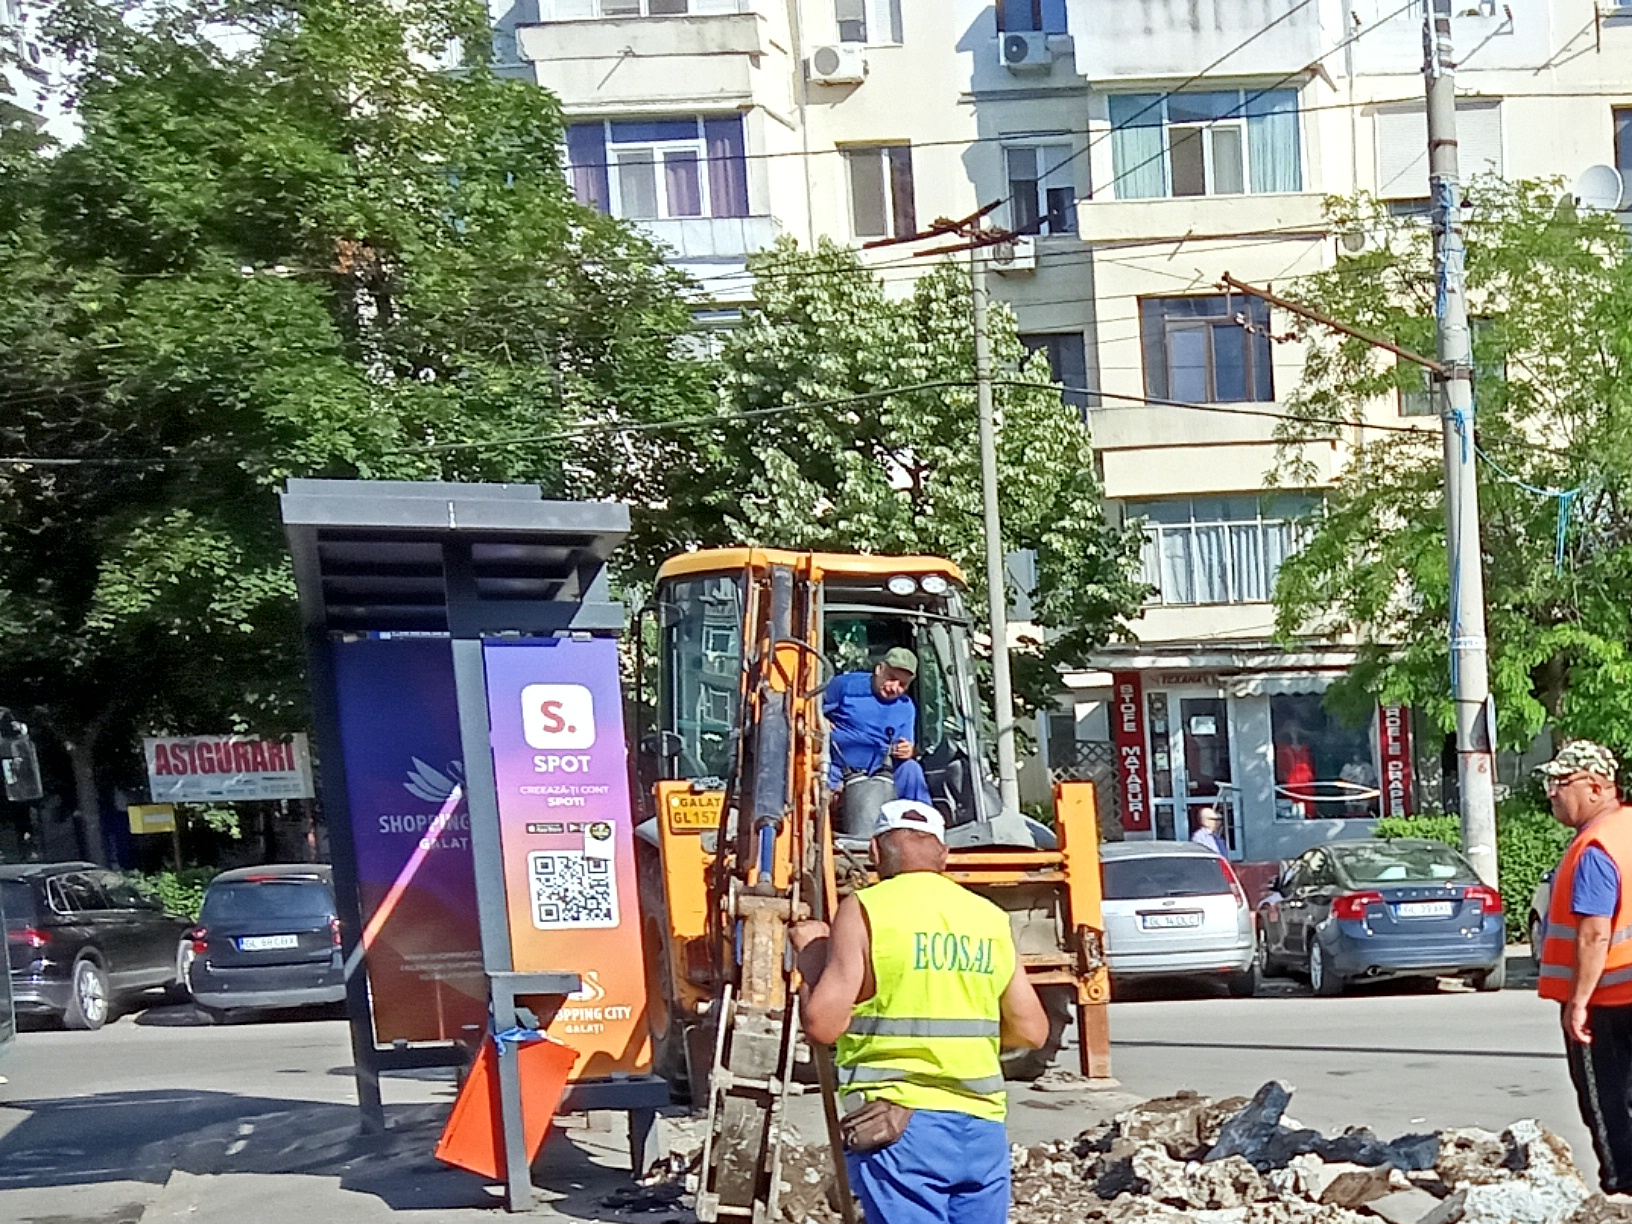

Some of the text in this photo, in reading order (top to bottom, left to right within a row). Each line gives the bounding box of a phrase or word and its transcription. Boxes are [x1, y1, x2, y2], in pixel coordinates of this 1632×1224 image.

[155, 741, 296, 776] ASIGURARI
[534, 755, 591, 773] SPOT
[1119, 684, 1144, 821] STOFE MATASURI
[581, 785, 610, 795] CONT
[913, 932, 995, 975] ECOSAL
[604, 1006, 632, 1020] CITY
